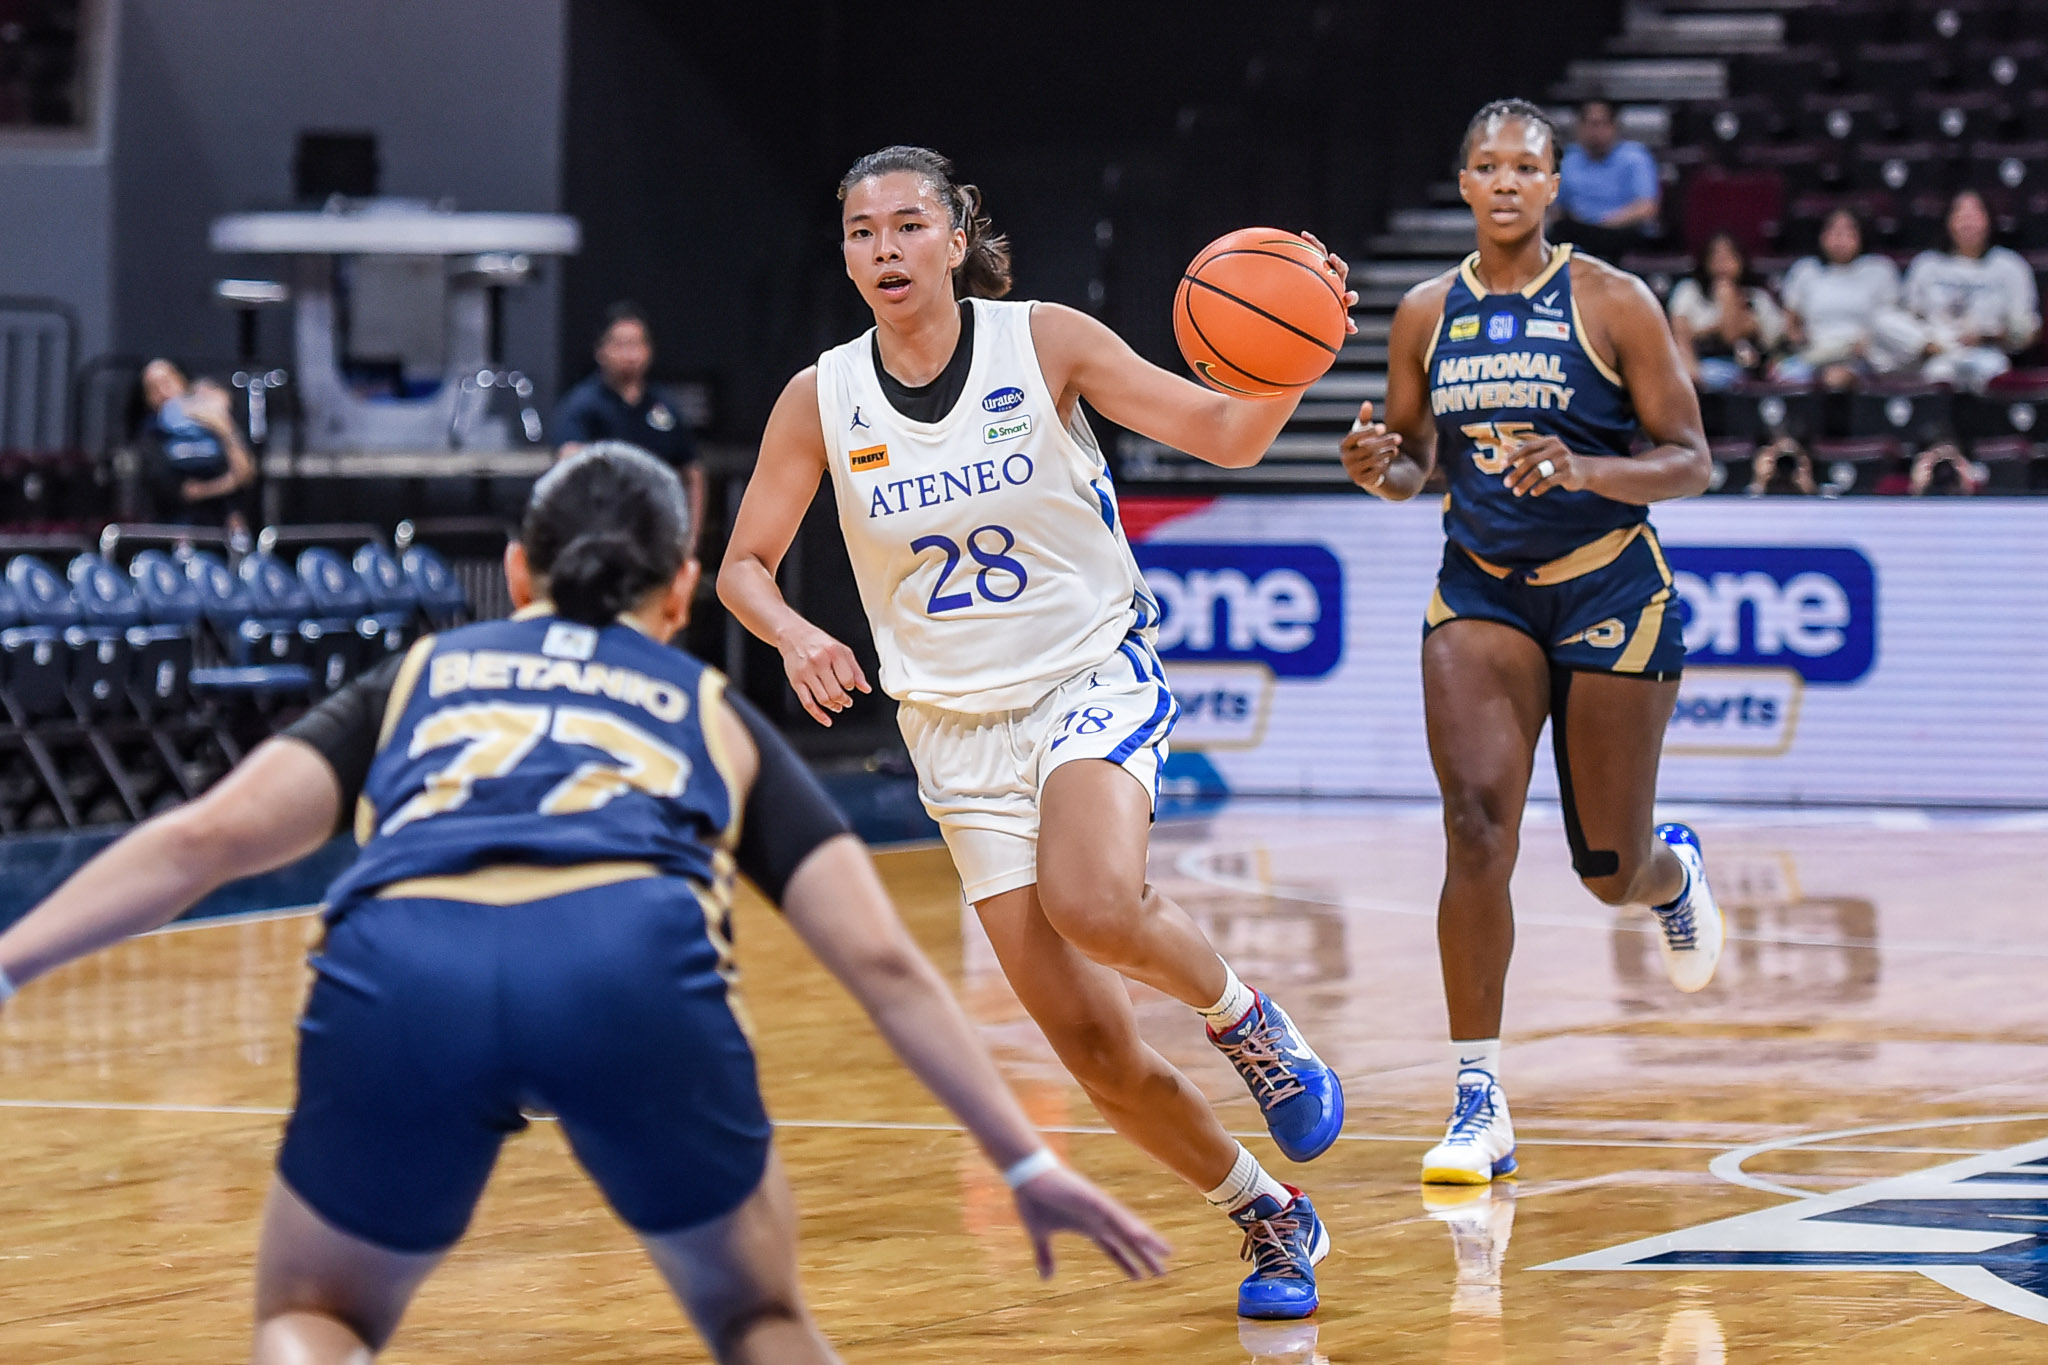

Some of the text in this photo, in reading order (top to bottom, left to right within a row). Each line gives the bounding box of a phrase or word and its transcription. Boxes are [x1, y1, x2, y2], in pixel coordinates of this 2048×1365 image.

[1437, 352, 1567, 386] NATIONAL
[983, 391, 1023, 410] Uratex
[998, 421, 1029, 437] Smart
[851, 450, 886, 466] FIREFLY
[868, 453, 1034, 518] ATENEO
[910, 524, 1028, 615] 28
[429, 649, 689, 724] BETANIO
[380, 701, 693, 837] 77
